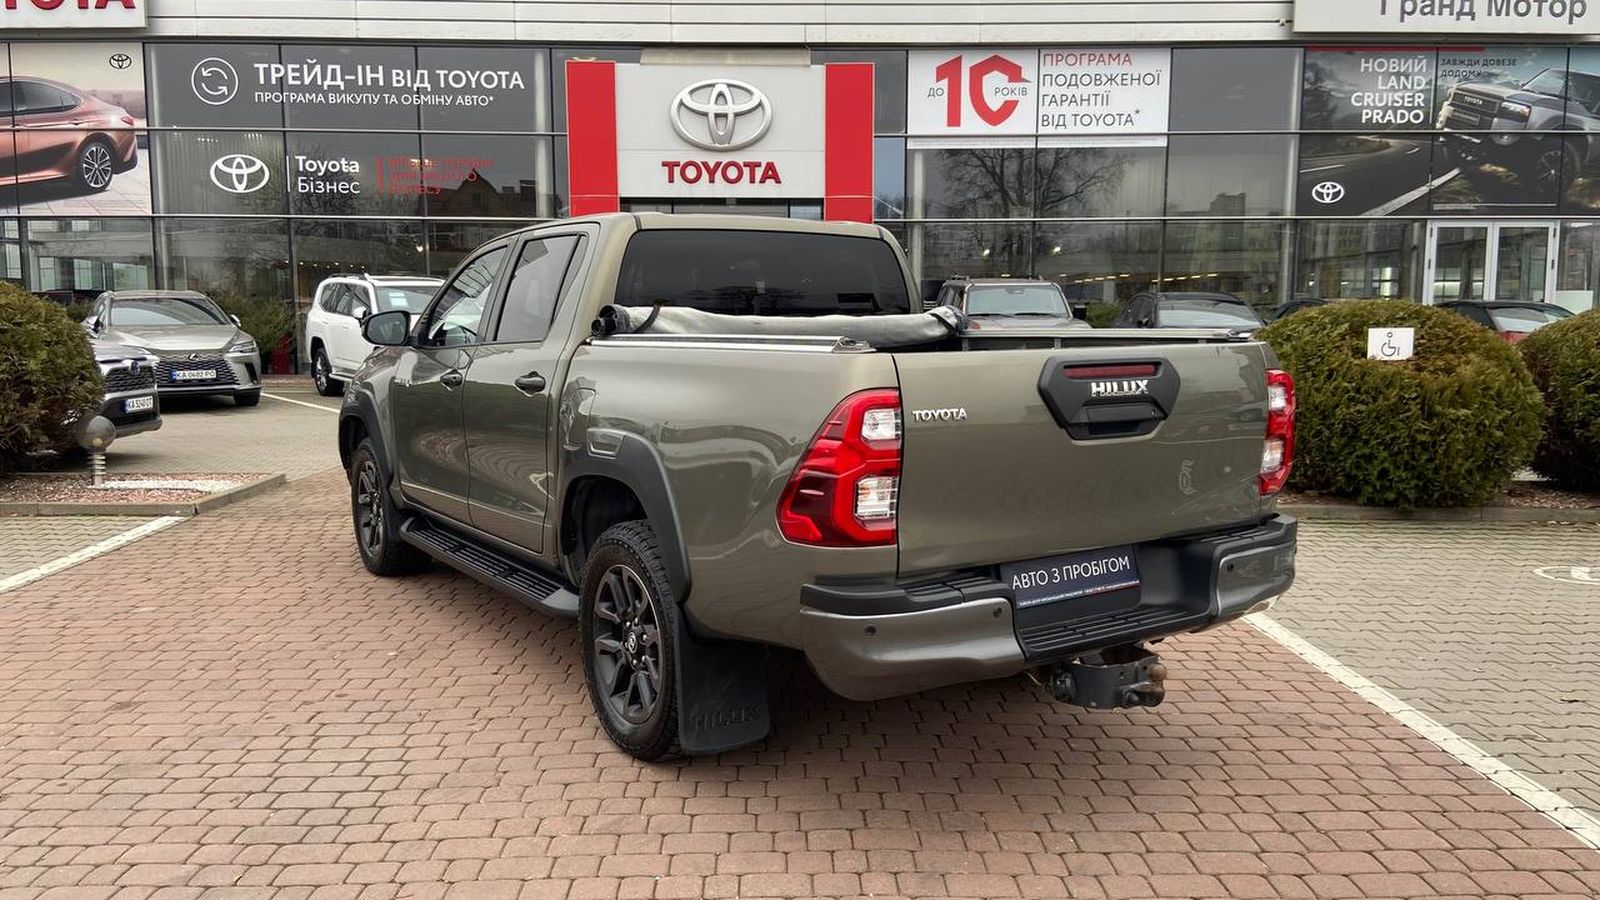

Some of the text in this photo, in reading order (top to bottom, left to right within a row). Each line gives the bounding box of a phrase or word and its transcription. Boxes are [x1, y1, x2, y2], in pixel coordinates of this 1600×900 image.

[1487, 0, 1587, 25] Мотор
[1043, 53, 1133, 67] ПРОГРАМА
[1360, 55, 1427, 73] НОВИЙ
[254, 59, 525, 92] ТРЕЙД-ІН ВІД TOYOTA
[1042, 69, 1163, 89] ПОДОВЖЕНОЇ
[1377, 75, 1426, 90] LAND
[254, 92, 326, 104] ПРОГРАМА
[328, 93, 380, 104] ВИКУПУ
[382, 94, 399, 105] ТА
[401, 94, 453, 106] ОБМІНУ
[927, 87, 945, 98] ДО
[994, 87, 1028, 97] РОКІВ
[1042, 90, 1111, 107] ГАРАНТІЇ
[1350, 92, 1425, 107] CRUISER
[1041, 114, 1067, 130] ВІД
[1361, 109, 1424, 124] PRADO
[294, 155, 360, 176] Toyota
[661, 160, 782, 184] TOYOTA
[297, 176, 361, 194] Бізнес
[1091, 380, 1149, 397] HILUX
[912, 408, 967, 421] TOYOTA
[1012, 570, 1049, 590] АВТО
[1062, 556, 1130, 581] ПРОБІГОМ
